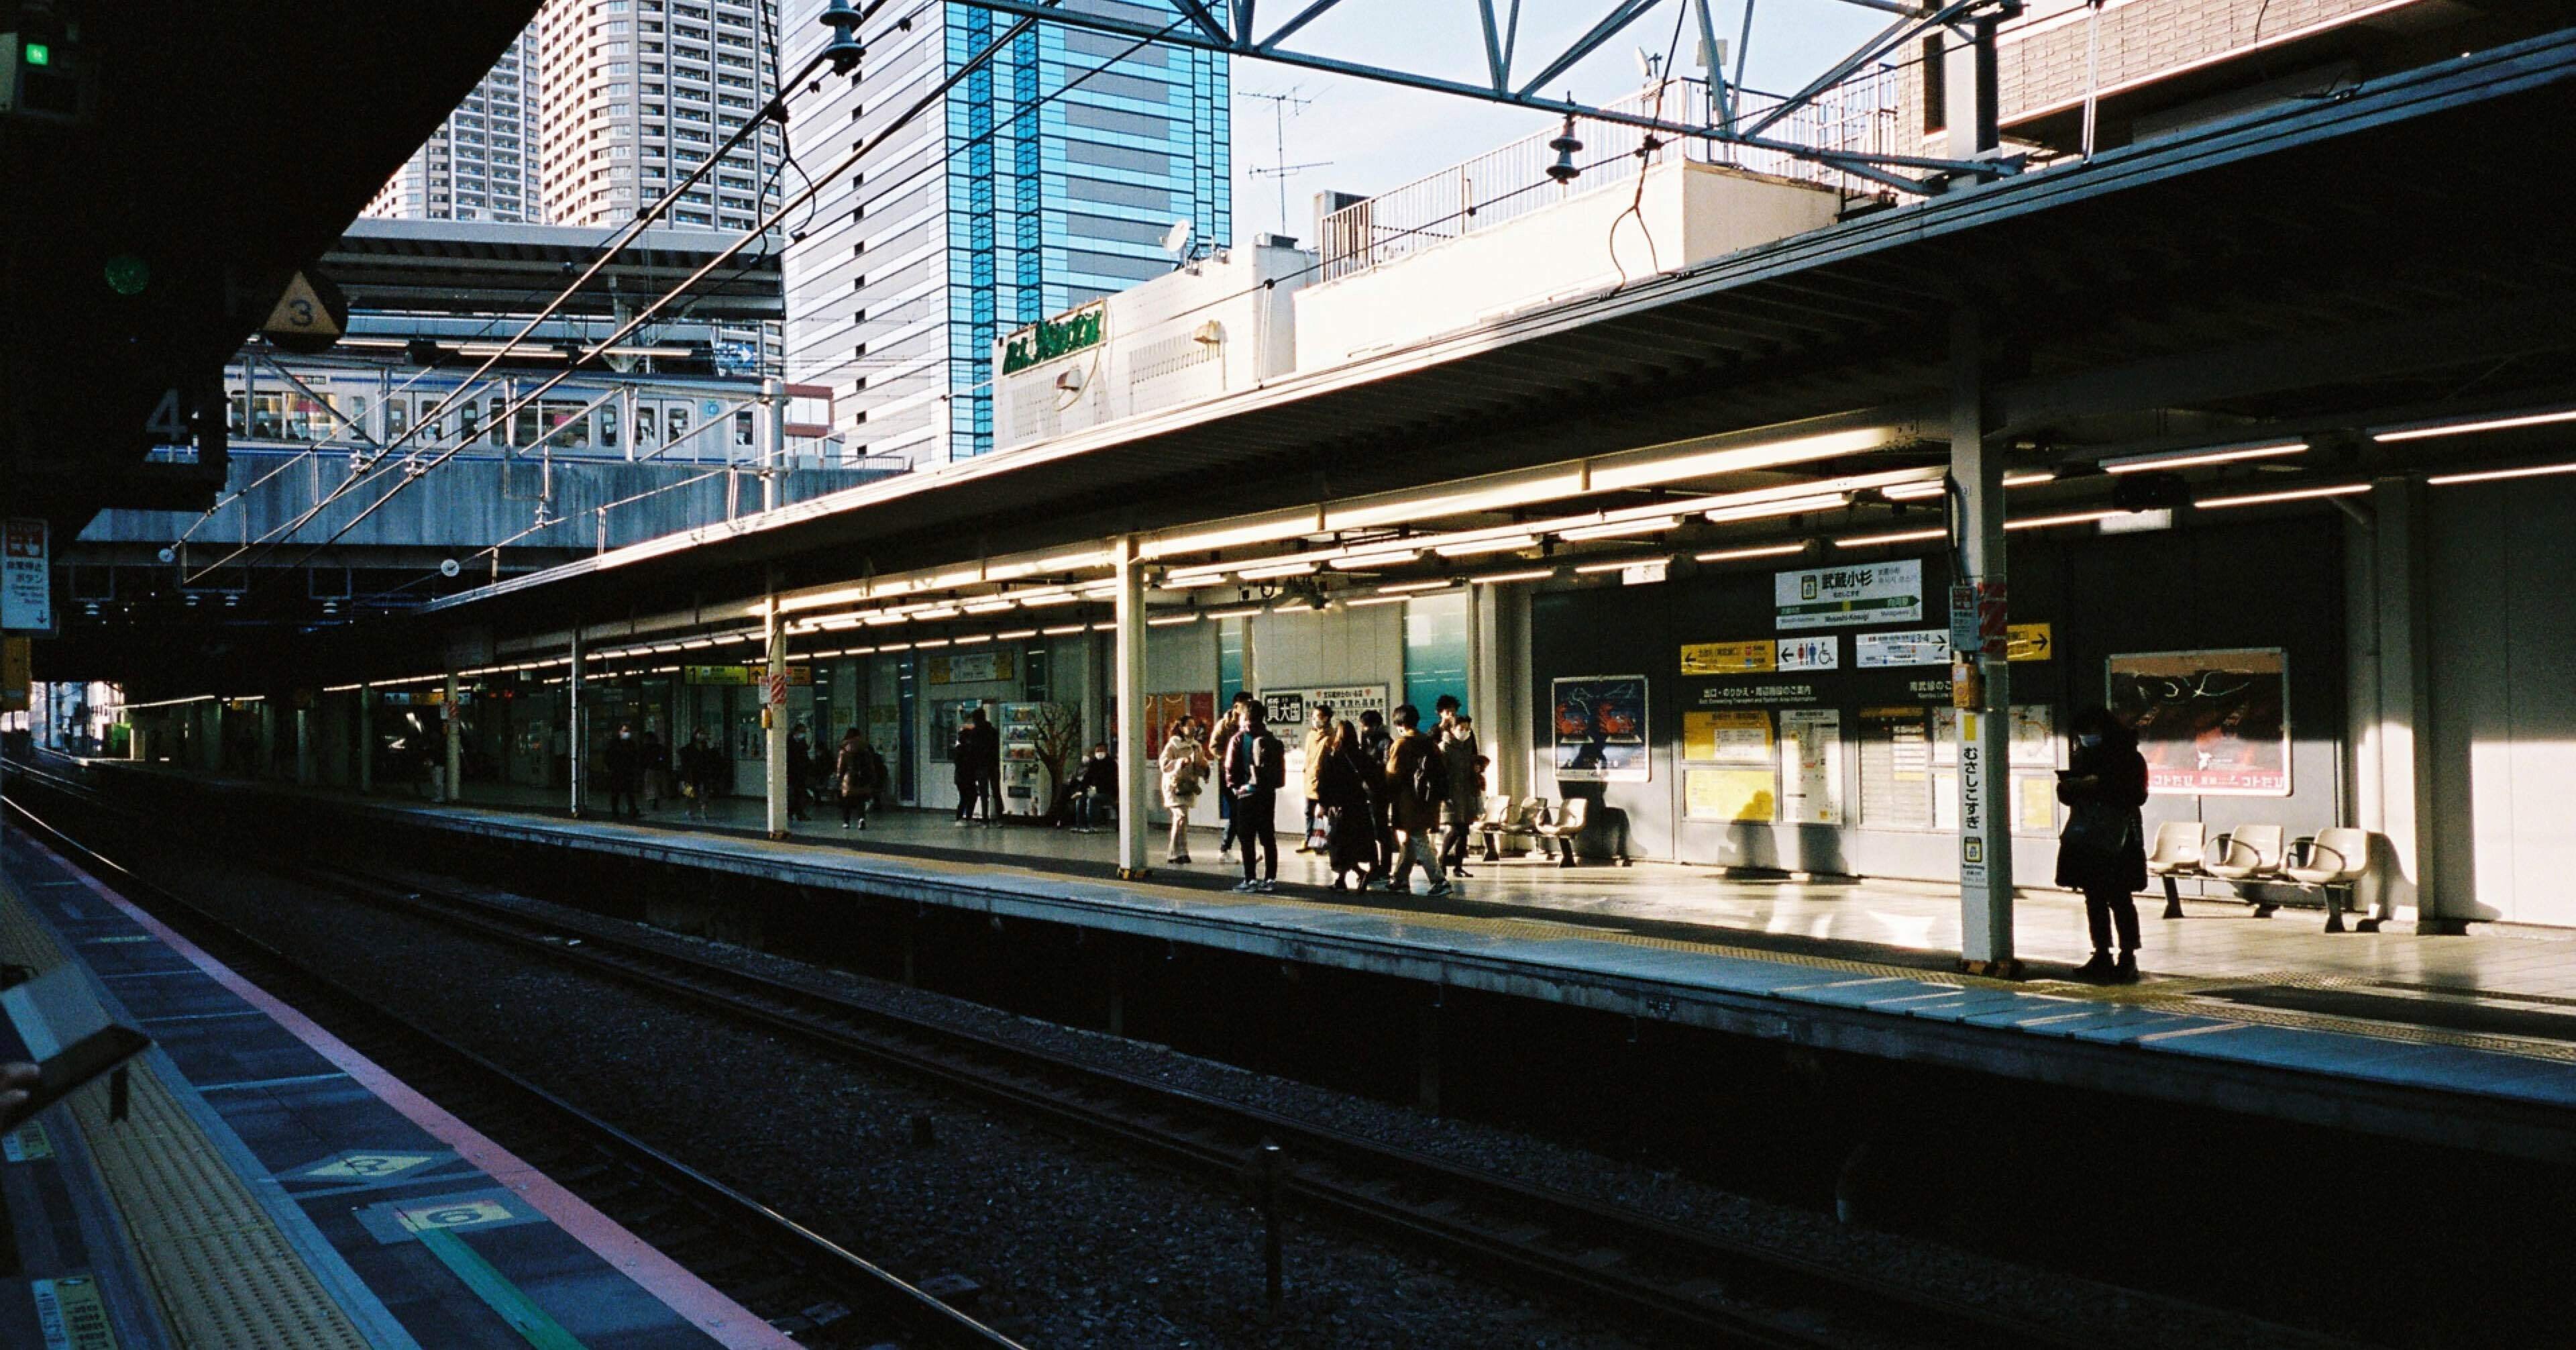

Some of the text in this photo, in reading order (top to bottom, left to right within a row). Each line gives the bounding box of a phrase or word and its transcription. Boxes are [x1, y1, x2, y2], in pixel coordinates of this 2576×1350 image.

[290, 299, 313, 327] 3
[146, 388, 188, 442] 4
[1821, 569, 1872, 590] 武蔵小杉
[1964, 746, 1980, 829] むさしこすぎ
